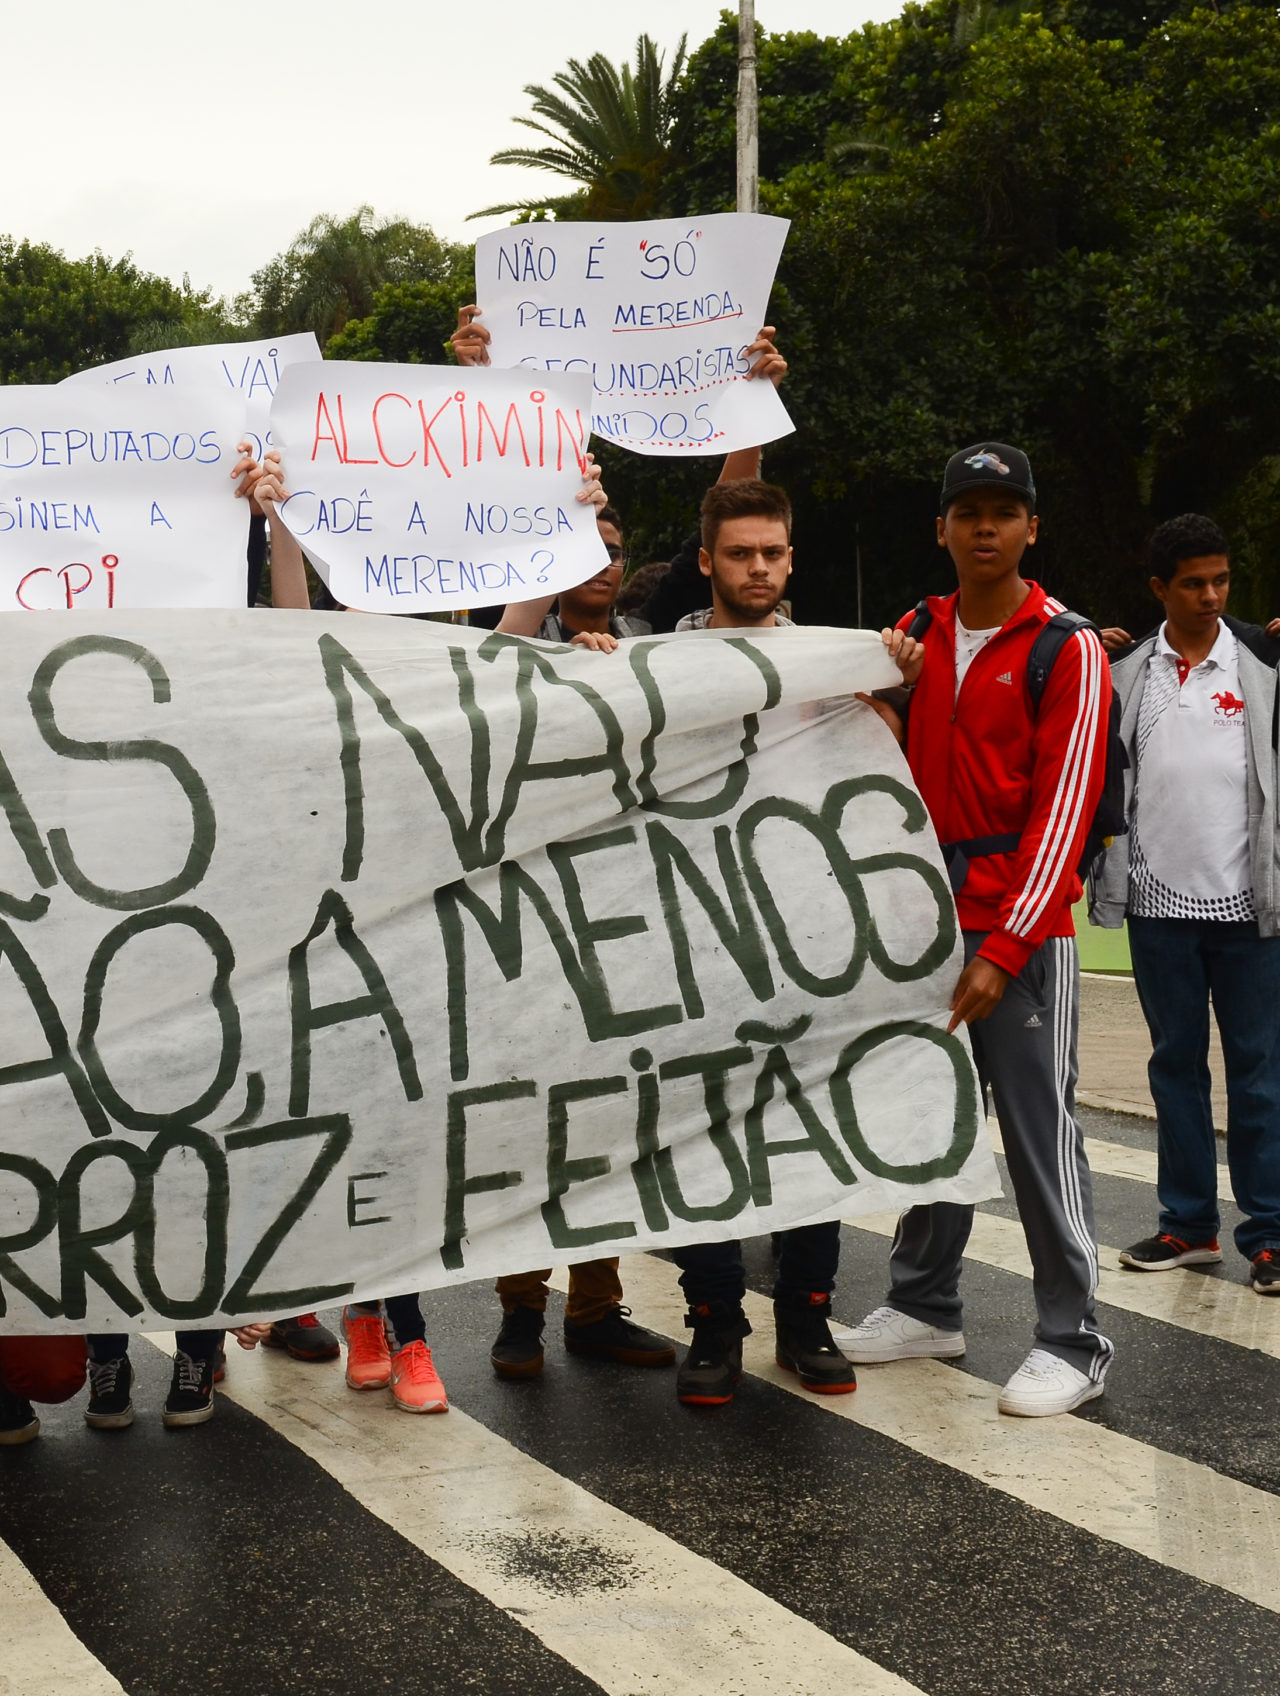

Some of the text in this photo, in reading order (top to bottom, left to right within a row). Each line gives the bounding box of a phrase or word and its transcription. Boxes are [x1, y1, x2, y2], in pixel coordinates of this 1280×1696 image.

[497, 236, 557, 282] NÃO
[585, 237, 605, 280] É
[517, 291, 744, 329] PELA MERENDA,
[150, 501, 173, 530] A
[280, 488, 574, 536] CADÊ A NOSSA
[365, 549, 555, 597] MERENDA?
[318, 632, 782, 882] NÃO
[287, 888, 424, 1118] A
[432, 773, 957, 1083] MENOS
